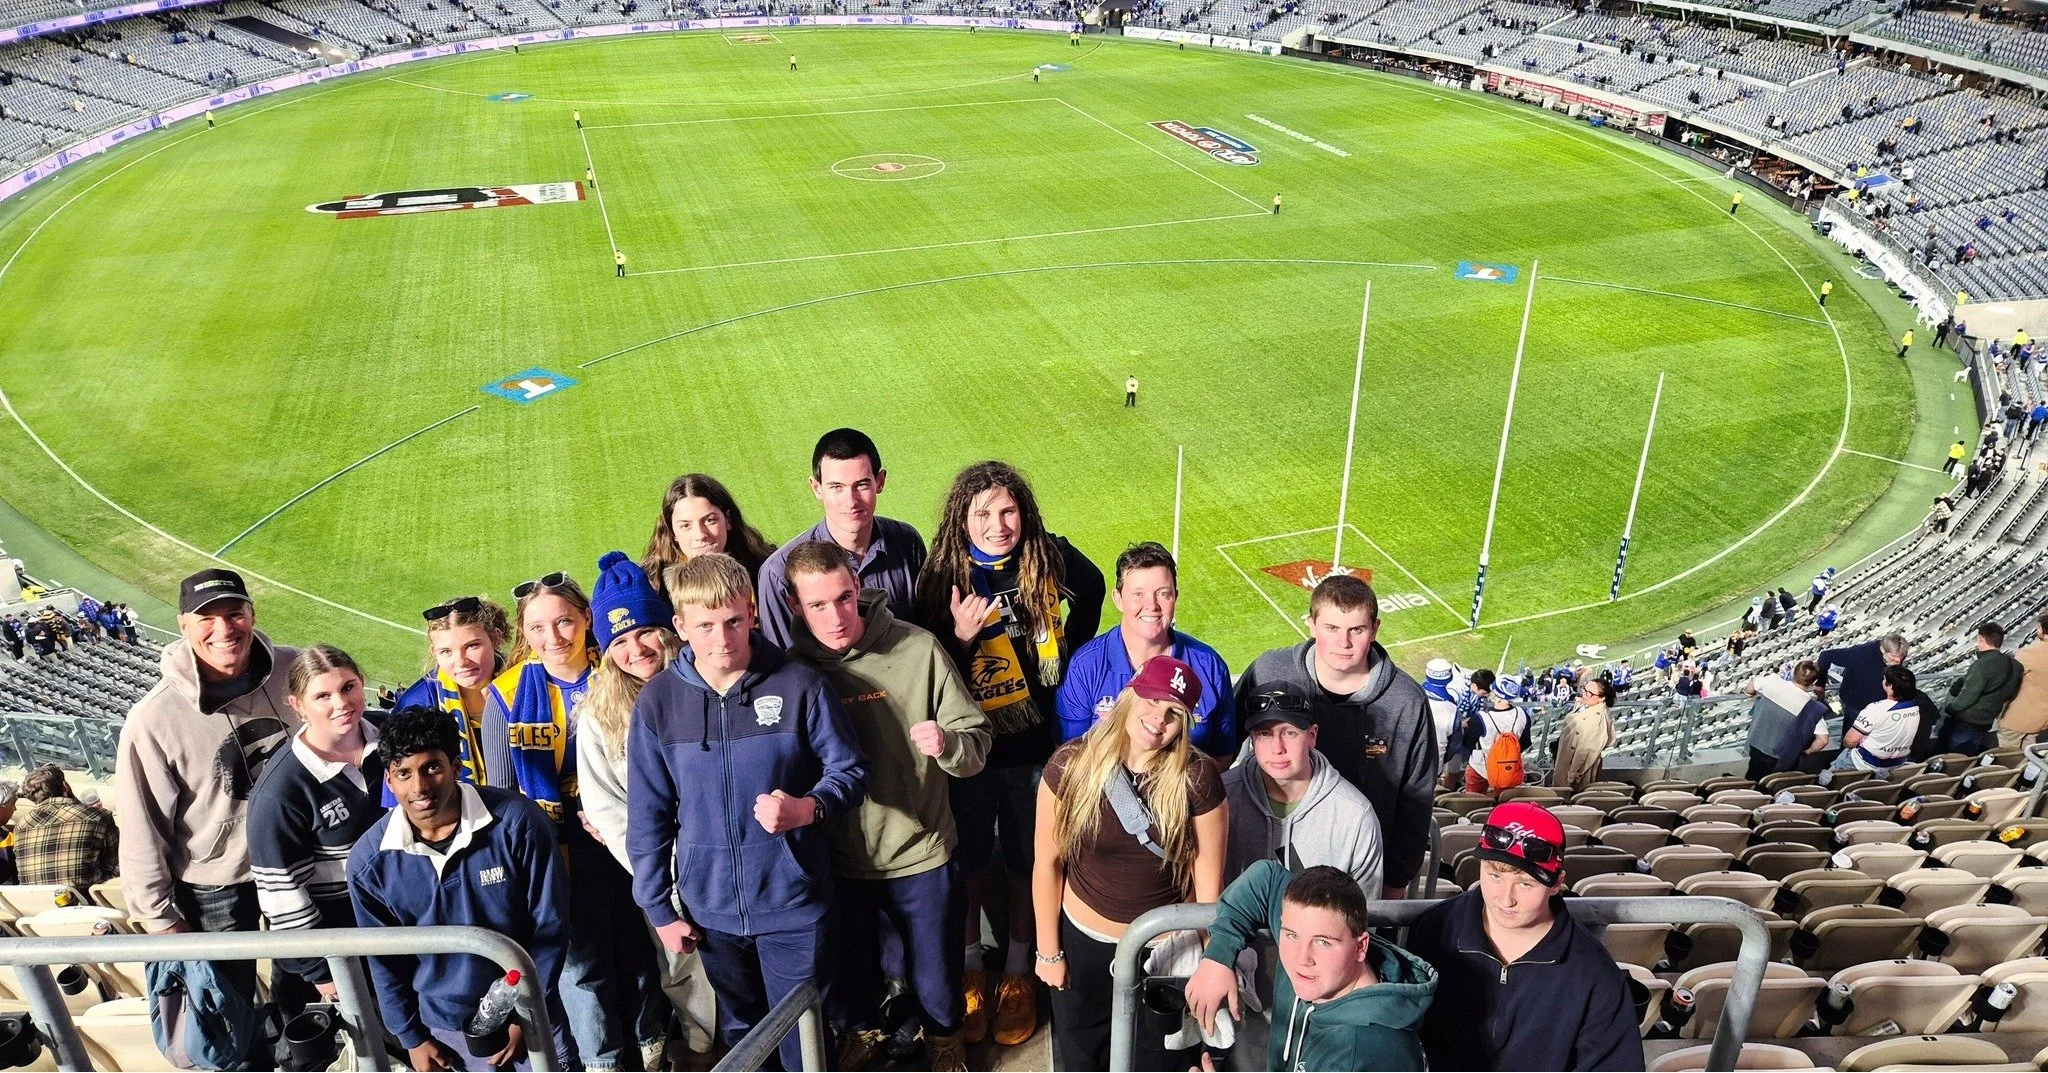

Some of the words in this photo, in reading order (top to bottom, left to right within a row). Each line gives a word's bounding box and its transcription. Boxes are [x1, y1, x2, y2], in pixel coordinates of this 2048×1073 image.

[973, 678, 1026, 701] AGLES
[1169, 666, 1187, 694] LA
[322, 802, 350, 828] 26
